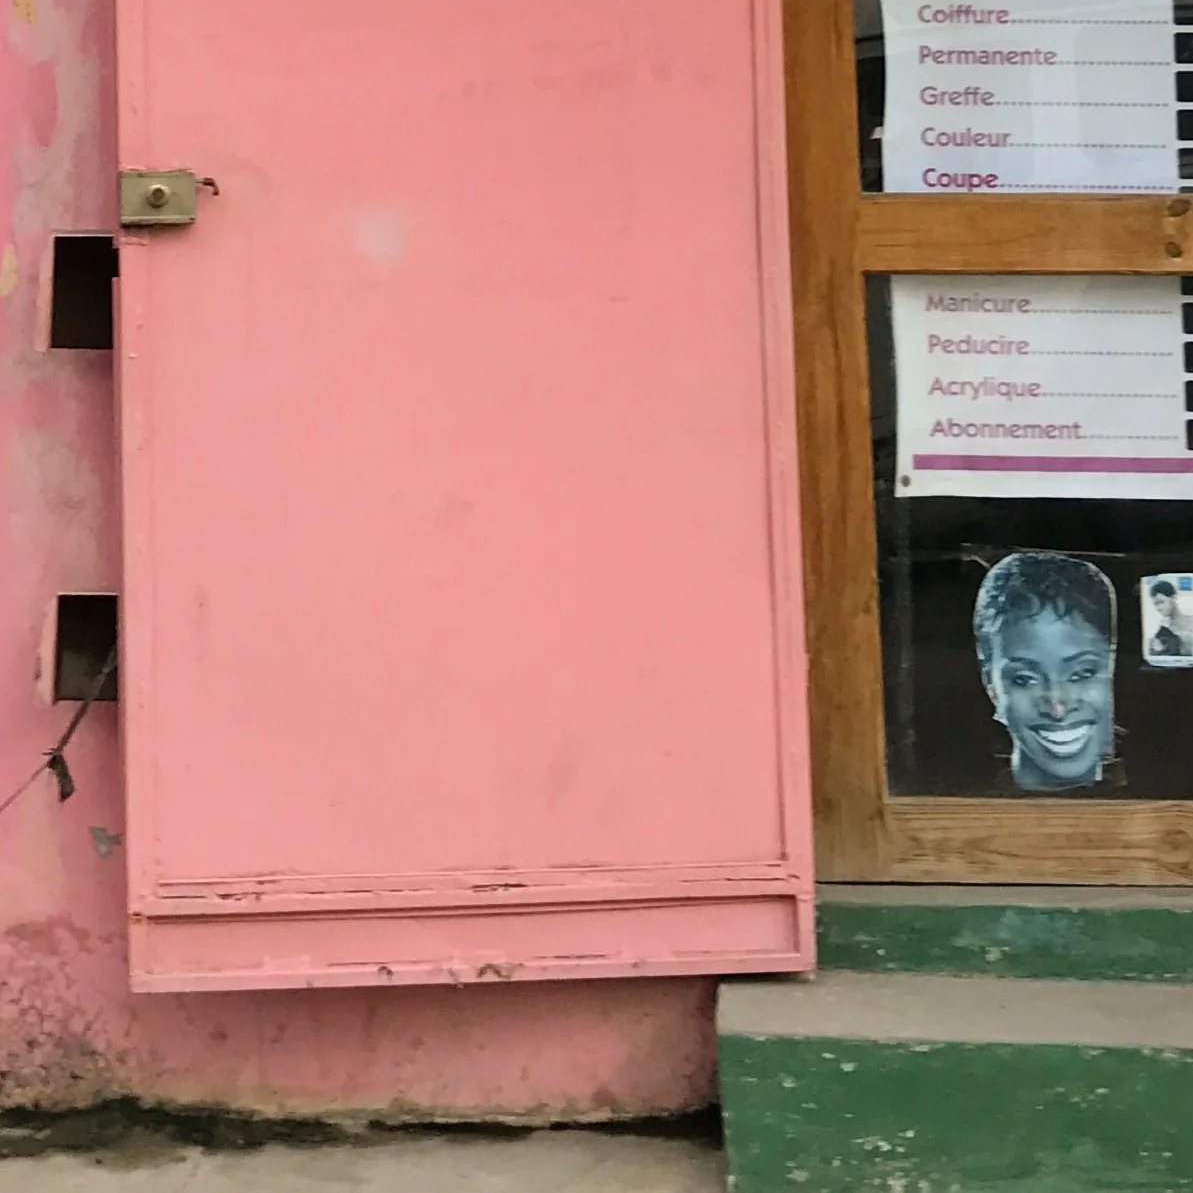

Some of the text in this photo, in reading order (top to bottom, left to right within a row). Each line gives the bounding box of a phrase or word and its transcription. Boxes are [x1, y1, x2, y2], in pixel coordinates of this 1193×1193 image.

[918, 4, 1009, 25] Coiffure
[918, 45, 1057, 66] Permanente
[919, 86, 995, 106] Greffe
[921, 127, 1011, 148] Couleur
[922, 168, 999, 192] Coupe
[926, 294, 1031, 314] Manicure
[927, 334, 1030, 356] Peducire
[928, 377, 1041, 401] Acrylique
[930, 419, 1082, 440] Abonnement
